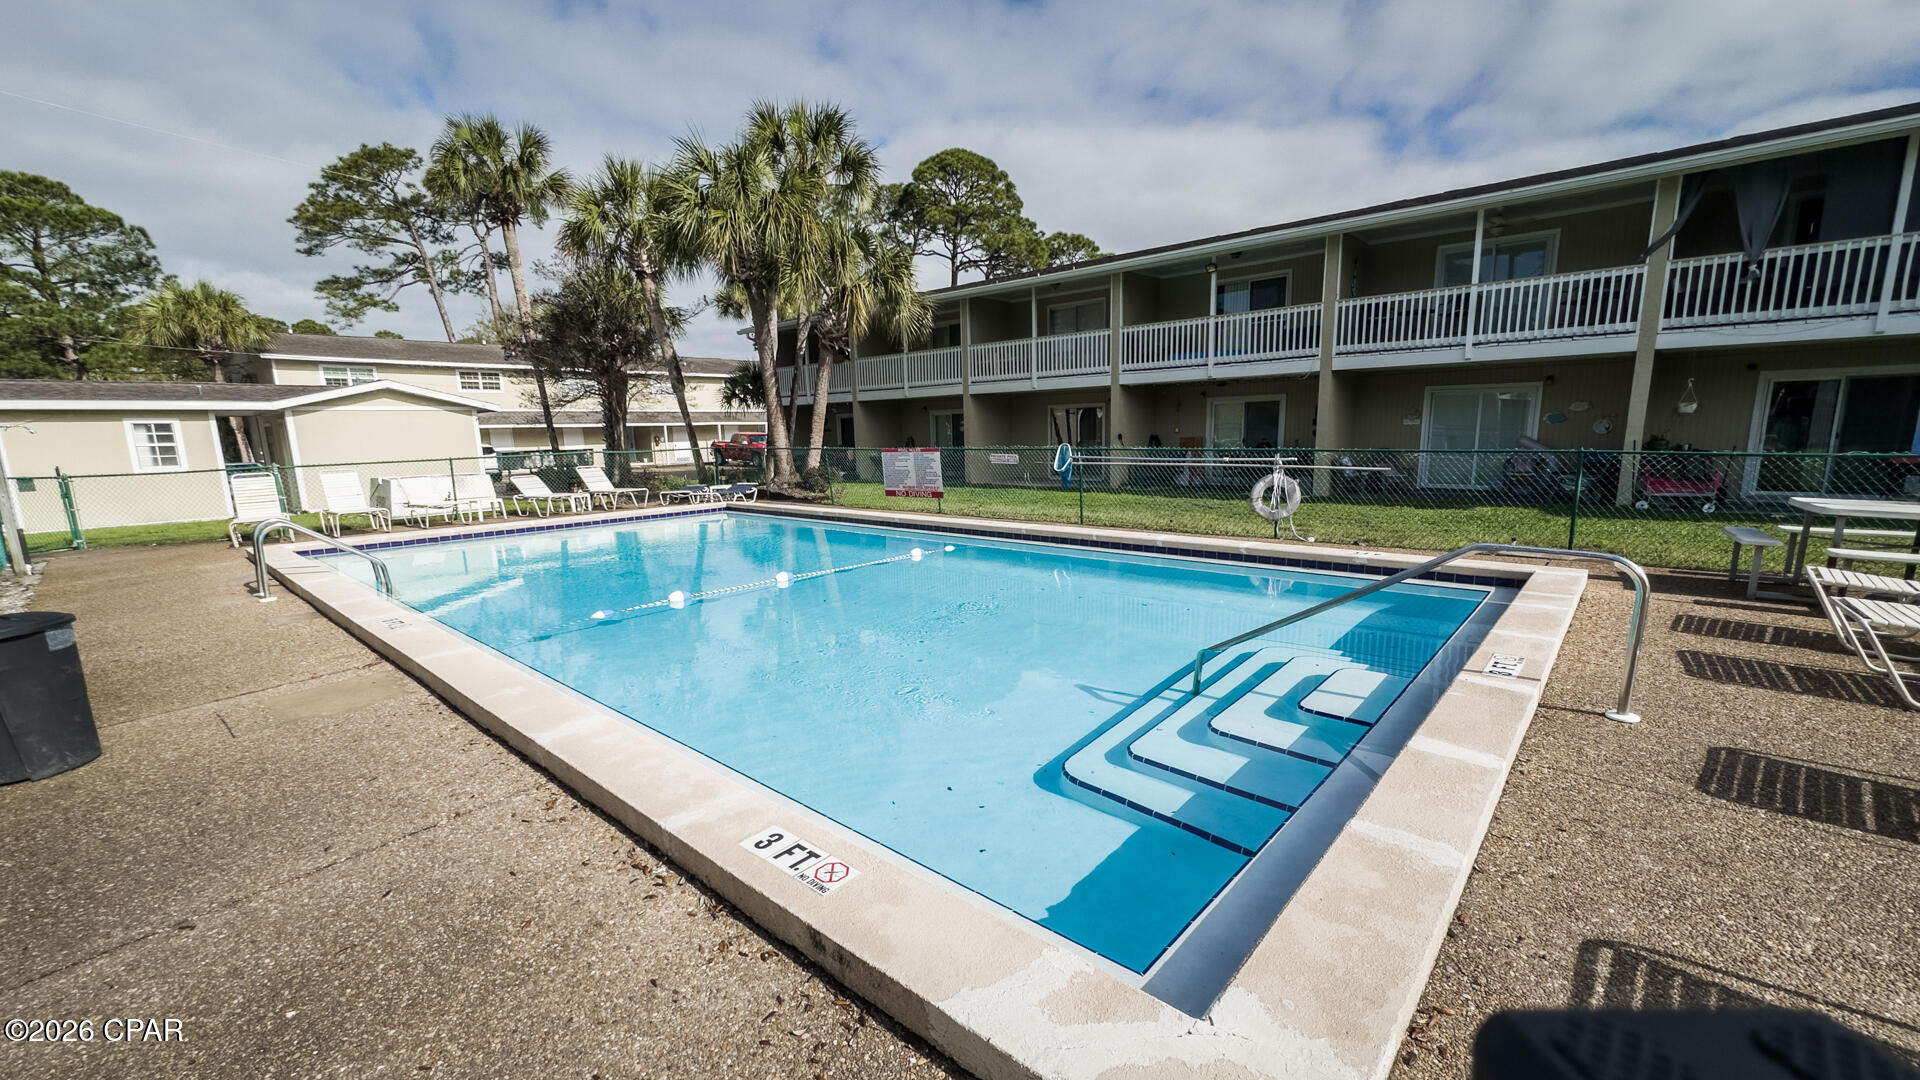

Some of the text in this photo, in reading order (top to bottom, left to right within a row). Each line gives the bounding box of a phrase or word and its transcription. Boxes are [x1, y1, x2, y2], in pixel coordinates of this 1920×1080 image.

[754, 833, 822, 871] 3 FT.
[797, 873, 830, 894] NO DIVING
